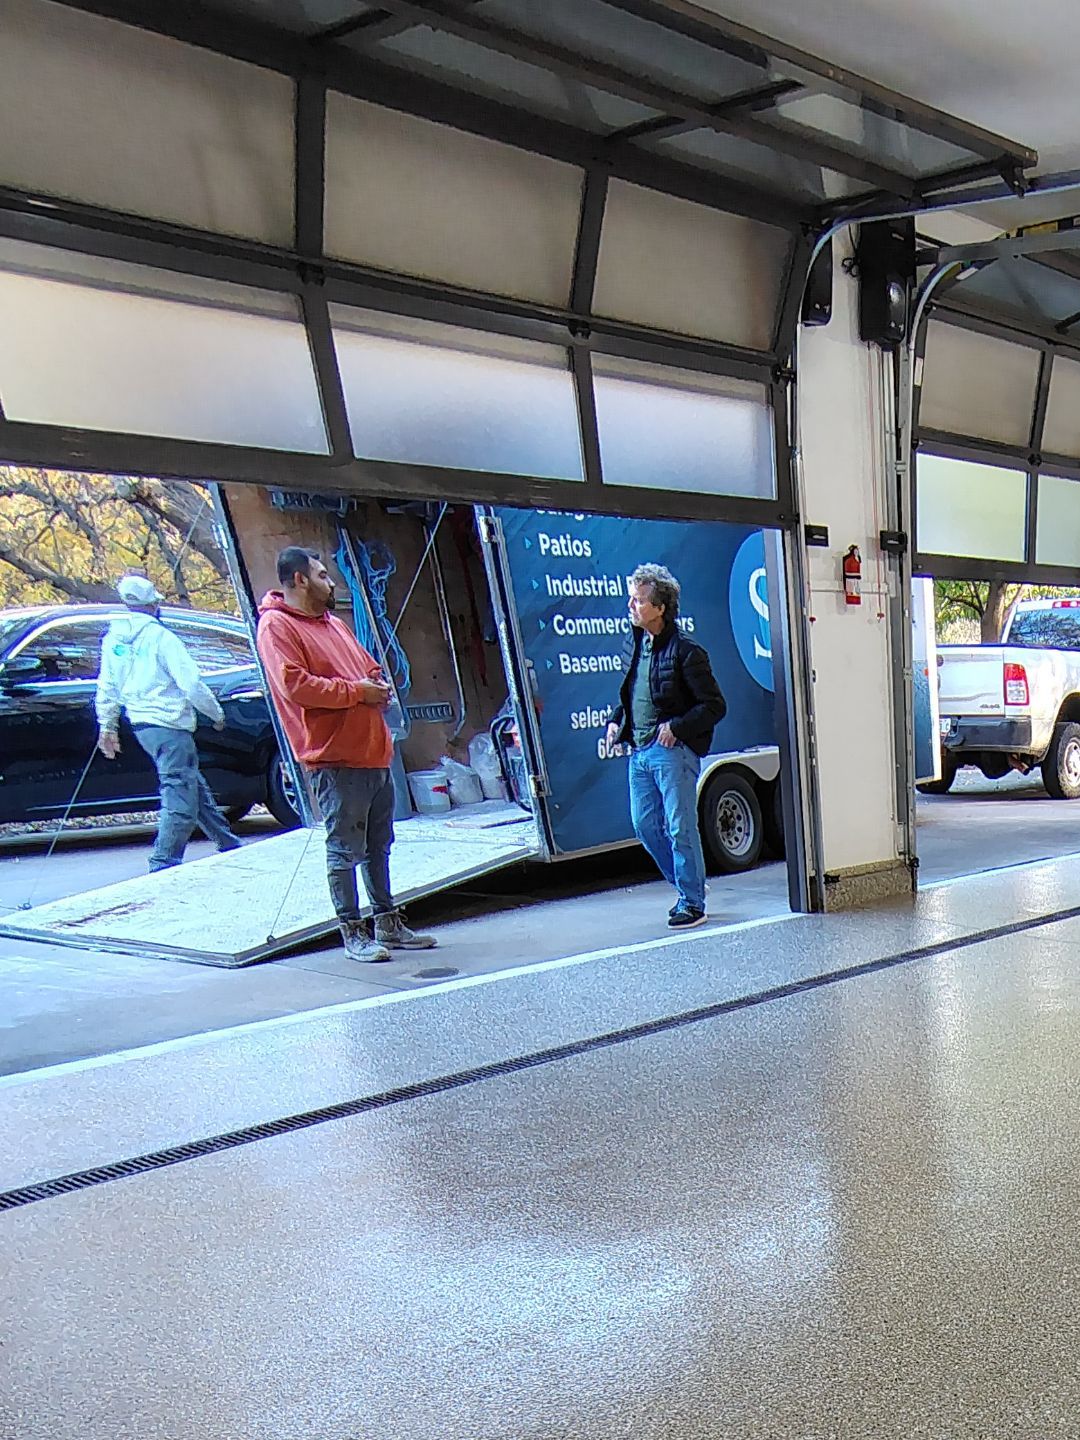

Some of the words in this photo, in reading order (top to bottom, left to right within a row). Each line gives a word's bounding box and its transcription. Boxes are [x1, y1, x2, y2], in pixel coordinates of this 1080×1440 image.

[538, 532, 592, 557] Patios
[545, 574, 623, 597] Industrial
[553, 614, 633, 636] Commerc
[559, 653, 622, 675] Baseme
